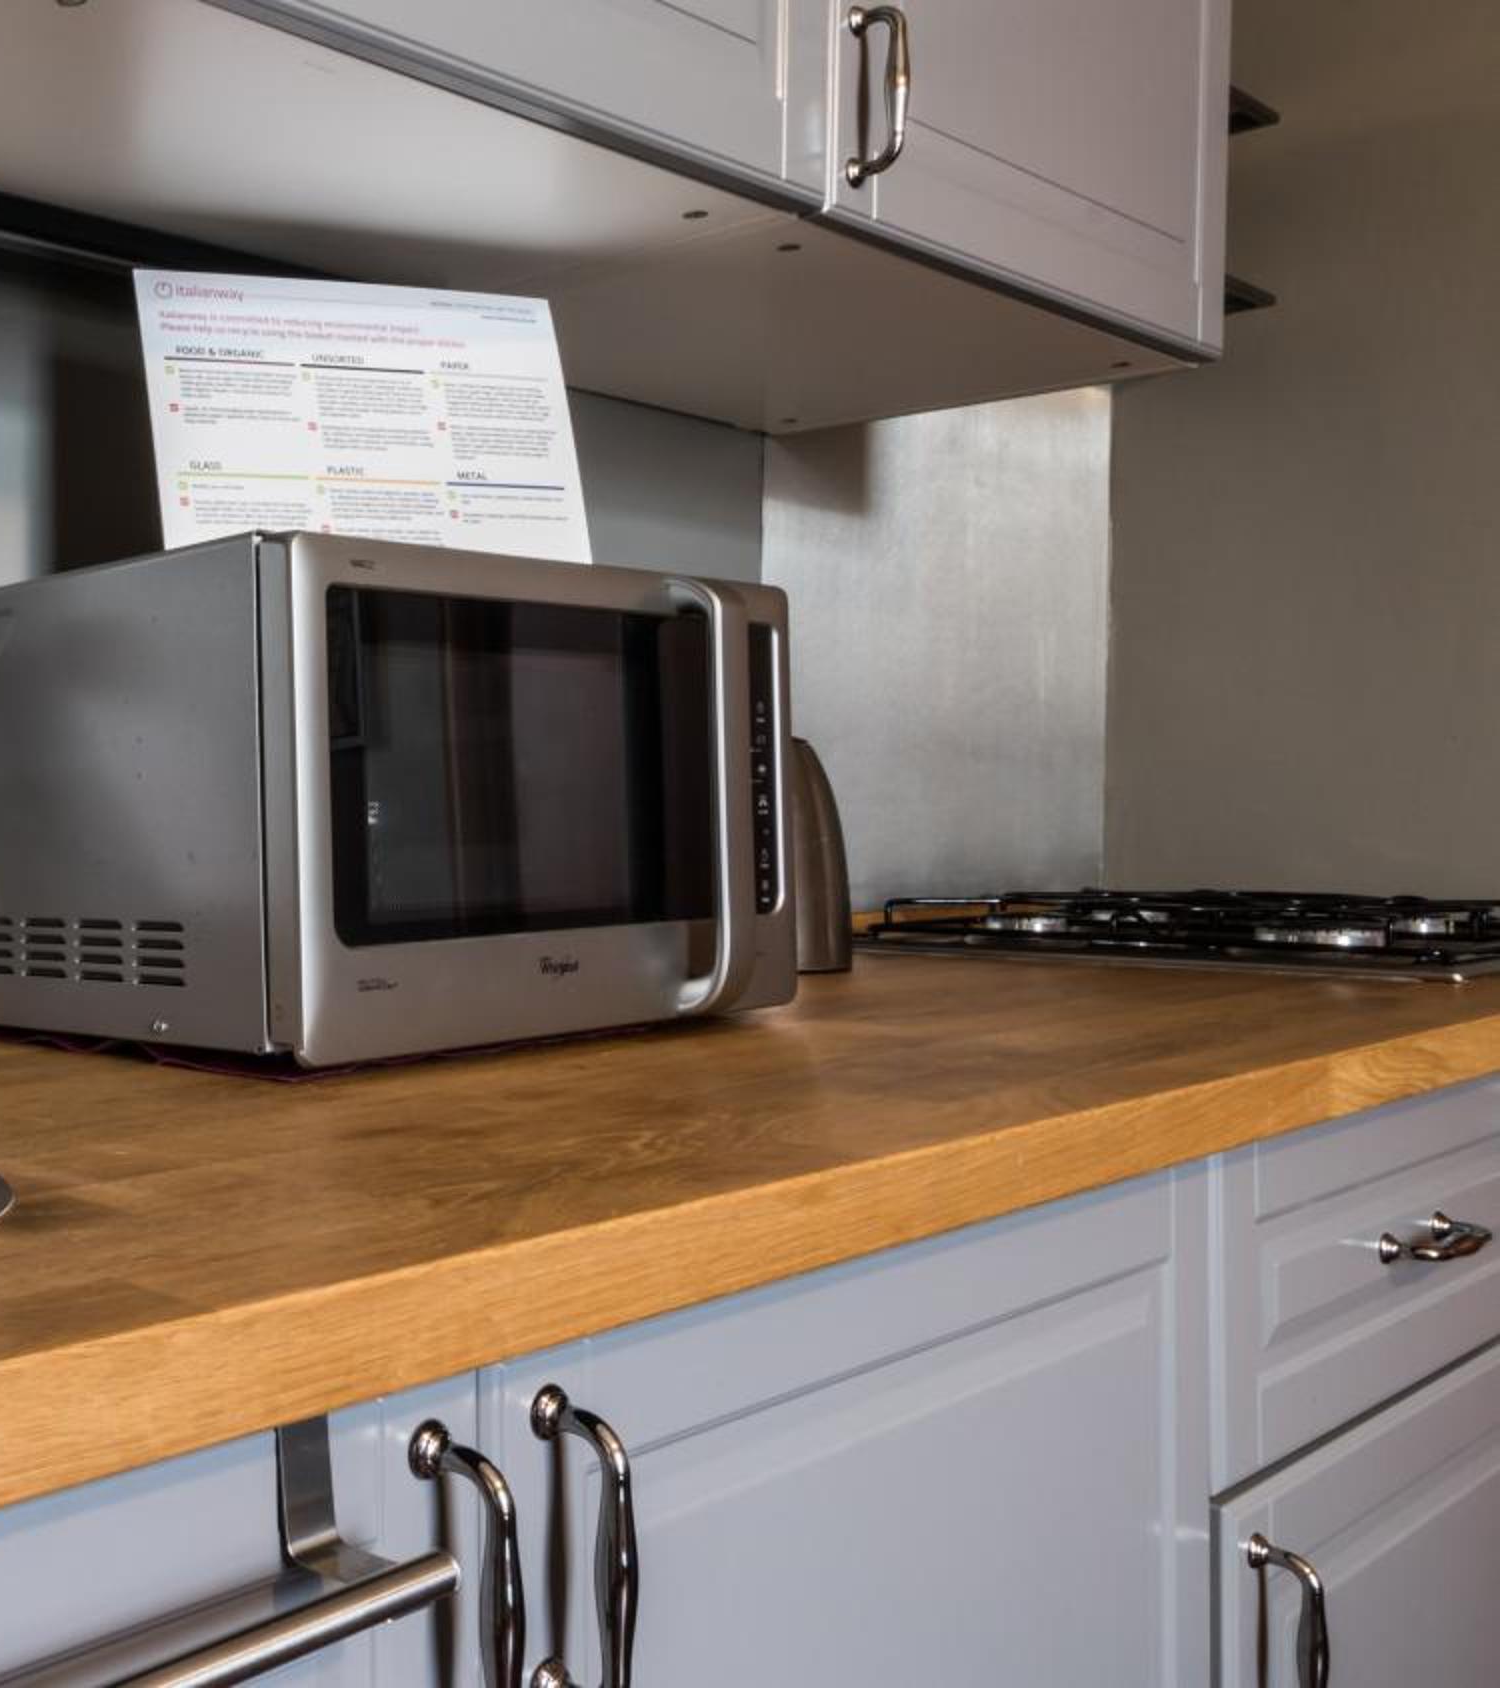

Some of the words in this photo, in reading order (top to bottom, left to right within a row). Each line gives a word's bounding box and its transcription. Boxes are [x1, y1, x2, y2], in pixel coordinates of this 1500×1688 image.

[175, 283, 244, 301] italianway
[160, 322, 191, 333] Please
[194, 323, 213, 335] help
[261, 328, 286, 339] using
[284, 318, 323, 331] reducing
[175, 345, 206, 356] FOOD
[208, 346, 217, 356] &
[218, 347, 265, 359] ORGANIC
[311, 353, 365, 365] UNSORTED
[440, 361, 469, 370] PAPER
[189, 460, 222, 471] GLASS
[326, 465, 364, 477] PLASTIC
[456, 471, 488, 481] METAL
